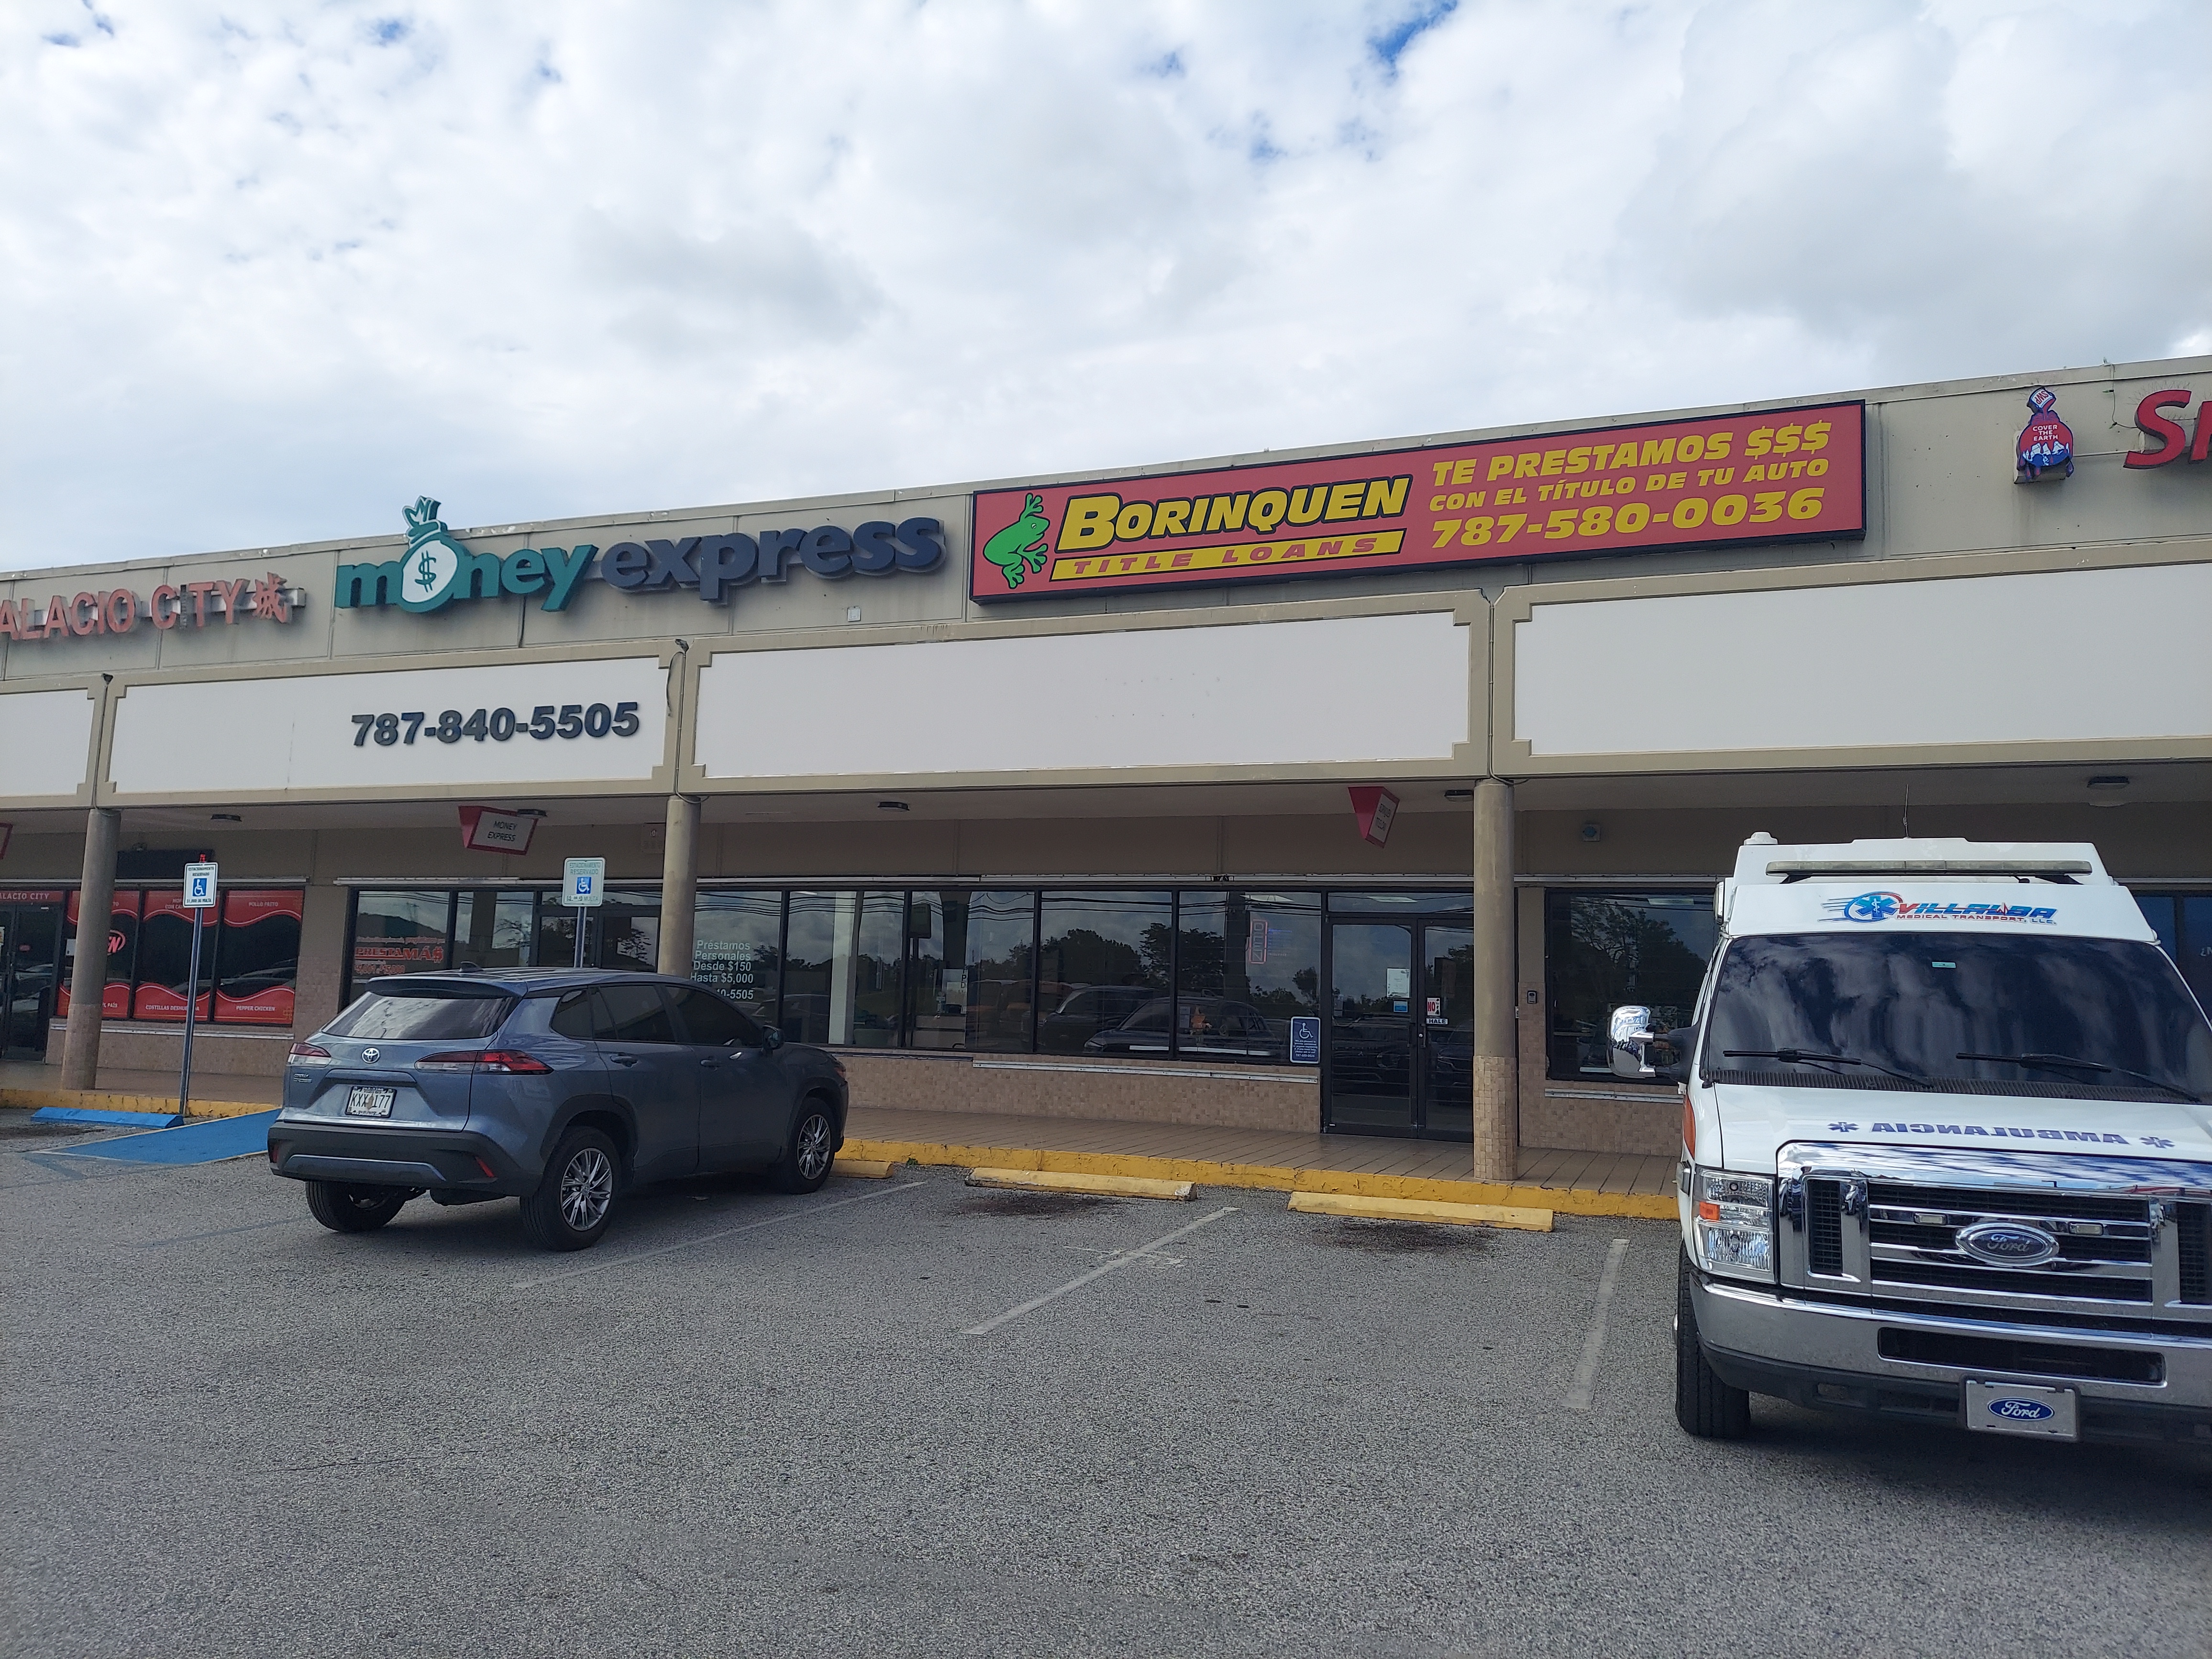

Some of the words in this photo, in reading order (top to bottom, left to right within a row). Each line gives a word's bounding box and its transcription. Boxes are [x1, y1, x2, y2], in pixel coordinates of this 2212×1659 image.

[2034, 390, 2049, 405] SWP
[1433, 458, 1478, 487] TE
[1486, 431, 1734, 481] PRESTAMOS
[1744, 419, 1832, 461] $$$
[1429, 491, 1486, 511] CON
[1494, 488, 1527, 505] EL
[1538, 476, 1637, 501] TÍTULO
[1645, 471, 1688, 492] DE
[1698, 467, 1737, 486] TU
[1742, 458, 1830, 483] AUTO
[1056, 476, 1412, 552] BORINQUEN
[1432, 487, 1825, 549] 787-580-0036
[1074, 553, 1194, 574] TITLE
[1221, 537, 1379, 564] LOANS
[151, 579, 246, 630] CITY
[352, 701, 640, 746] 787-840-5505
[493, 820, 518, 830] MONEY
[487, 831, 517, 842] EXPRESS
[697, 940, 751, 950] Préstamos
[695, 950, 751, 961] Personales
[694, 961, 725, 971] Desde
[727, 961, 752, 972] $150
[690, 972, 718, 983] Hasta
[721, 972, 753, 984] $5,000
[717, 989, 754, 1000] 0-5505
[1427, 1001, 1436, 1012] NO
[350, 1093, 369, 1107] KXX
[371, 1095, 391, 1109] 177
[1987, 1233, 2031, 1253] Ford
[2001, 1401, 2041, 1418] Ford
